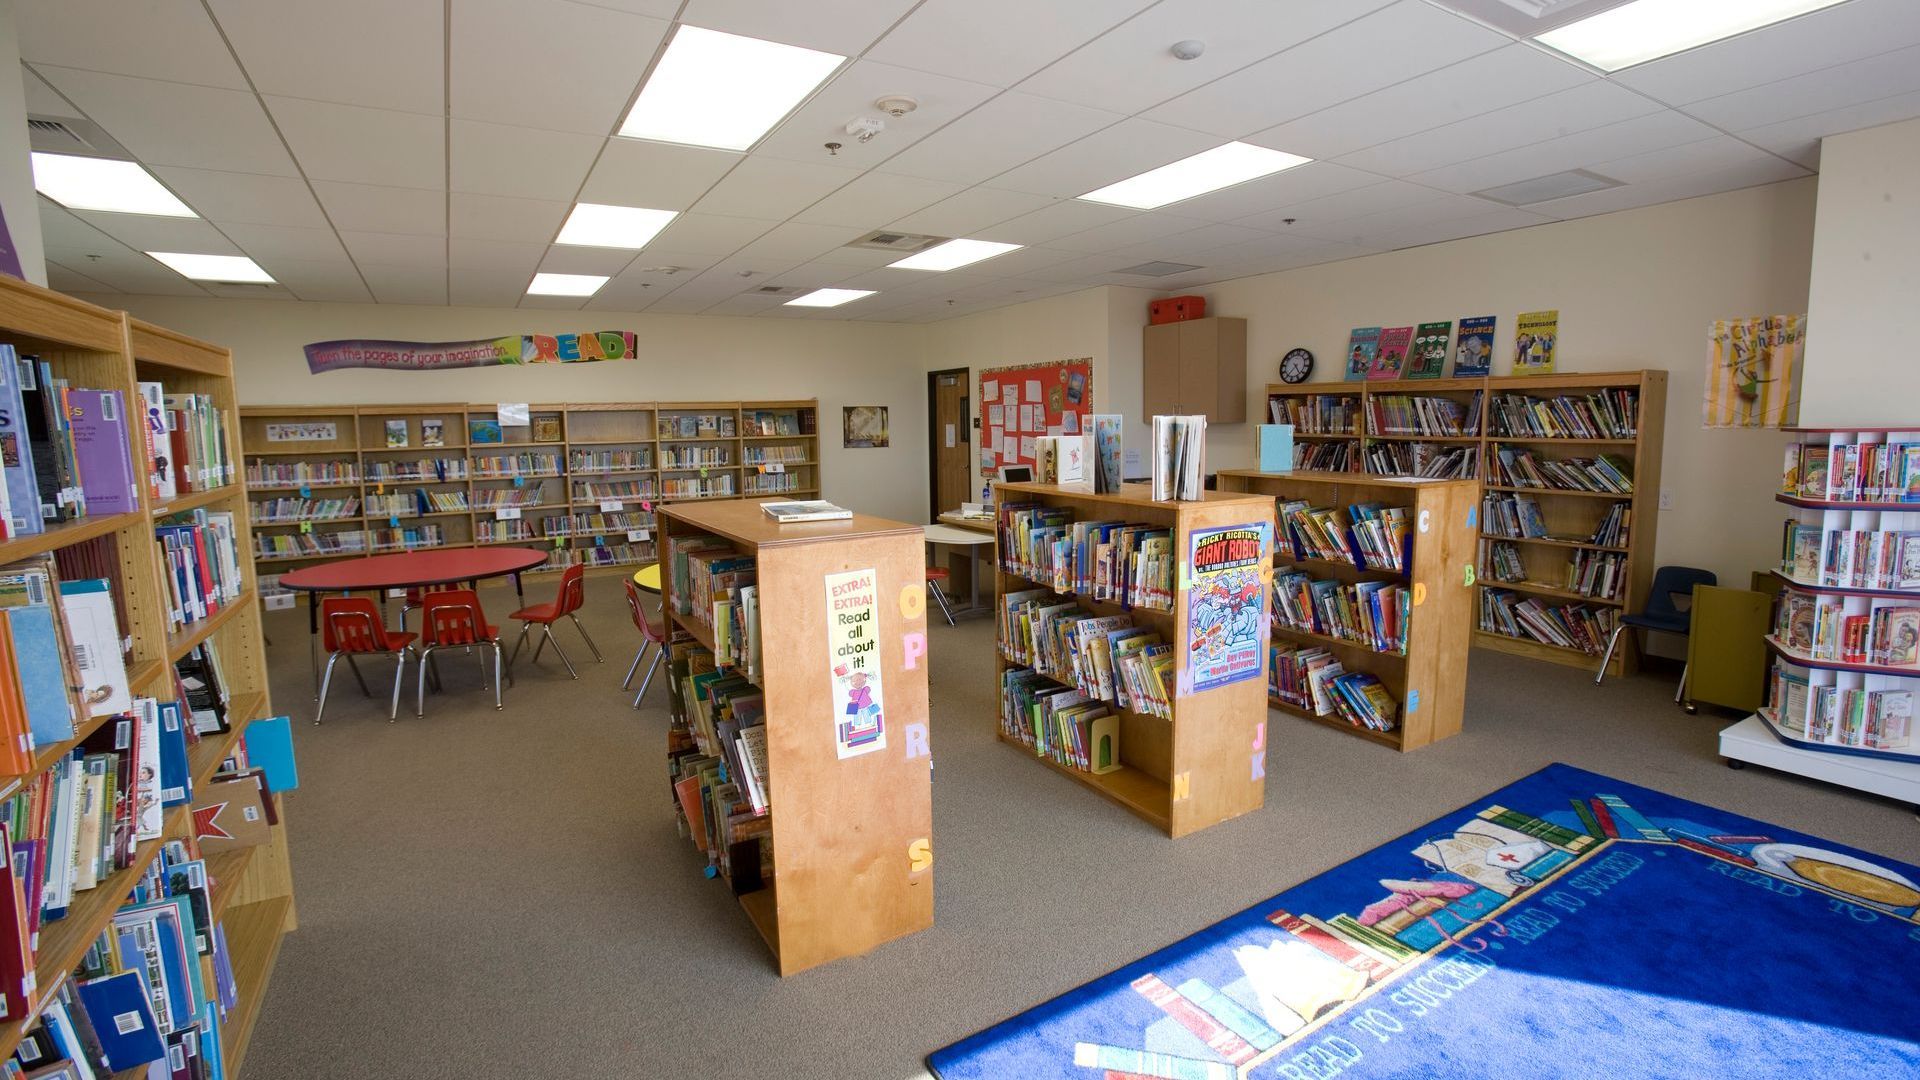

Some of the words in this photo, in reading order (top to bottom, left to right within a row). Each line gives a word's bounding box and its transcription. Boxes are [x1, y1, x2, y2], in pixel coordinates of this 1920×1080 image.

[363, 349, 399, 367] pages
[401, 349, 416, 364] of
[418, 352, 443, 367] your
[533, 331, 635, 364] READ!
[1418, 510, 1430, 533] C
[1466, 505, 1477, 528] A
[1194, 540, 1227, 565] GIANT
[1229, 539, 1260, 561] ROBOT
[1202, 533, 1224, 546] RICKY
[832, 576, 871, 597] EXTRA!
[1464, 564, 1475, 587] B
[834, 594, 873, 611] EXTRA!
[900, 584, 925, 619] O
[1414, 582, 1426, 606] D
[838, 608, 870, 626] Read
[848, 625, 863, 639] all
[837, 640, 875, 657] about
[904, 633, 927, 670] P
[853, 655, 865, 669] it!
[1407, 689, 1420, 714] E
[905, 723, 930, 758] R
[1252, 723, 1264, 750] J
[1251, 752, 1265, 781] K
[1174, 772, 1190, 801] N
[908, 838, 933, 873] S
[1706, 860, 1803, 897] READ
[1828, 899, 1879, 922] TO
[1504, 907, 1560, 945] READ
[1543, 890, 1586, 914] TO
[1350, 1007, 1403, 1043] TO
[1390, 951, 1497, 1017] SUCCEED
